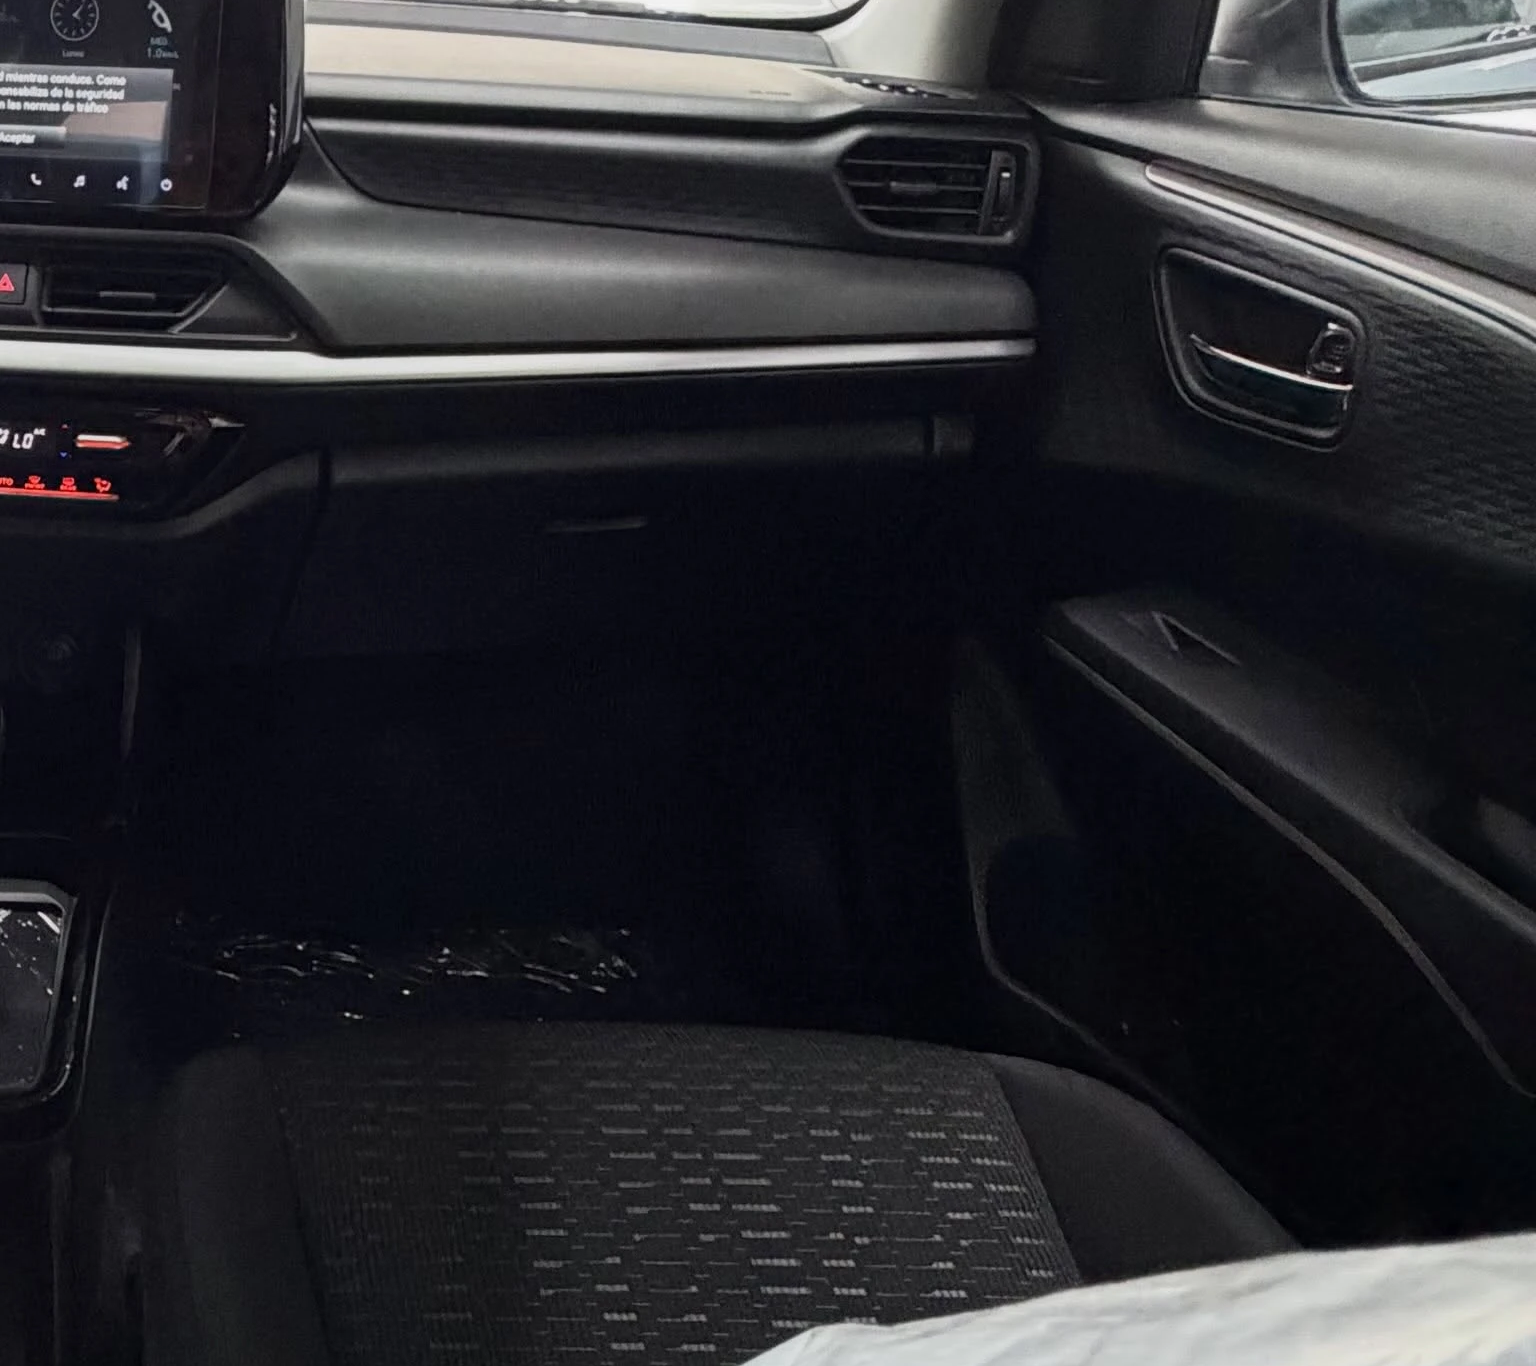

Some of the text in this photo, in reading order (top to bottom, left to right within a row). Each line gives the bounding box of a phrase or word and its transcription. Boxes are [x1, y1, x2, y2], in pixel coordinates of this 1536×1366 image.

[5, 72, 49, 84] mientras
[50, 73, 94, 85] conduce.
[96, 74, 127, 86] Como
[50, 87, 63, 98] de
[64, 87, 74, 99] la
[76, 88, 125, 101] seguridad
[7, 99, 22, 111] las
[23, 101, 60, 112] normas
[62, 101, 75, 112] de
